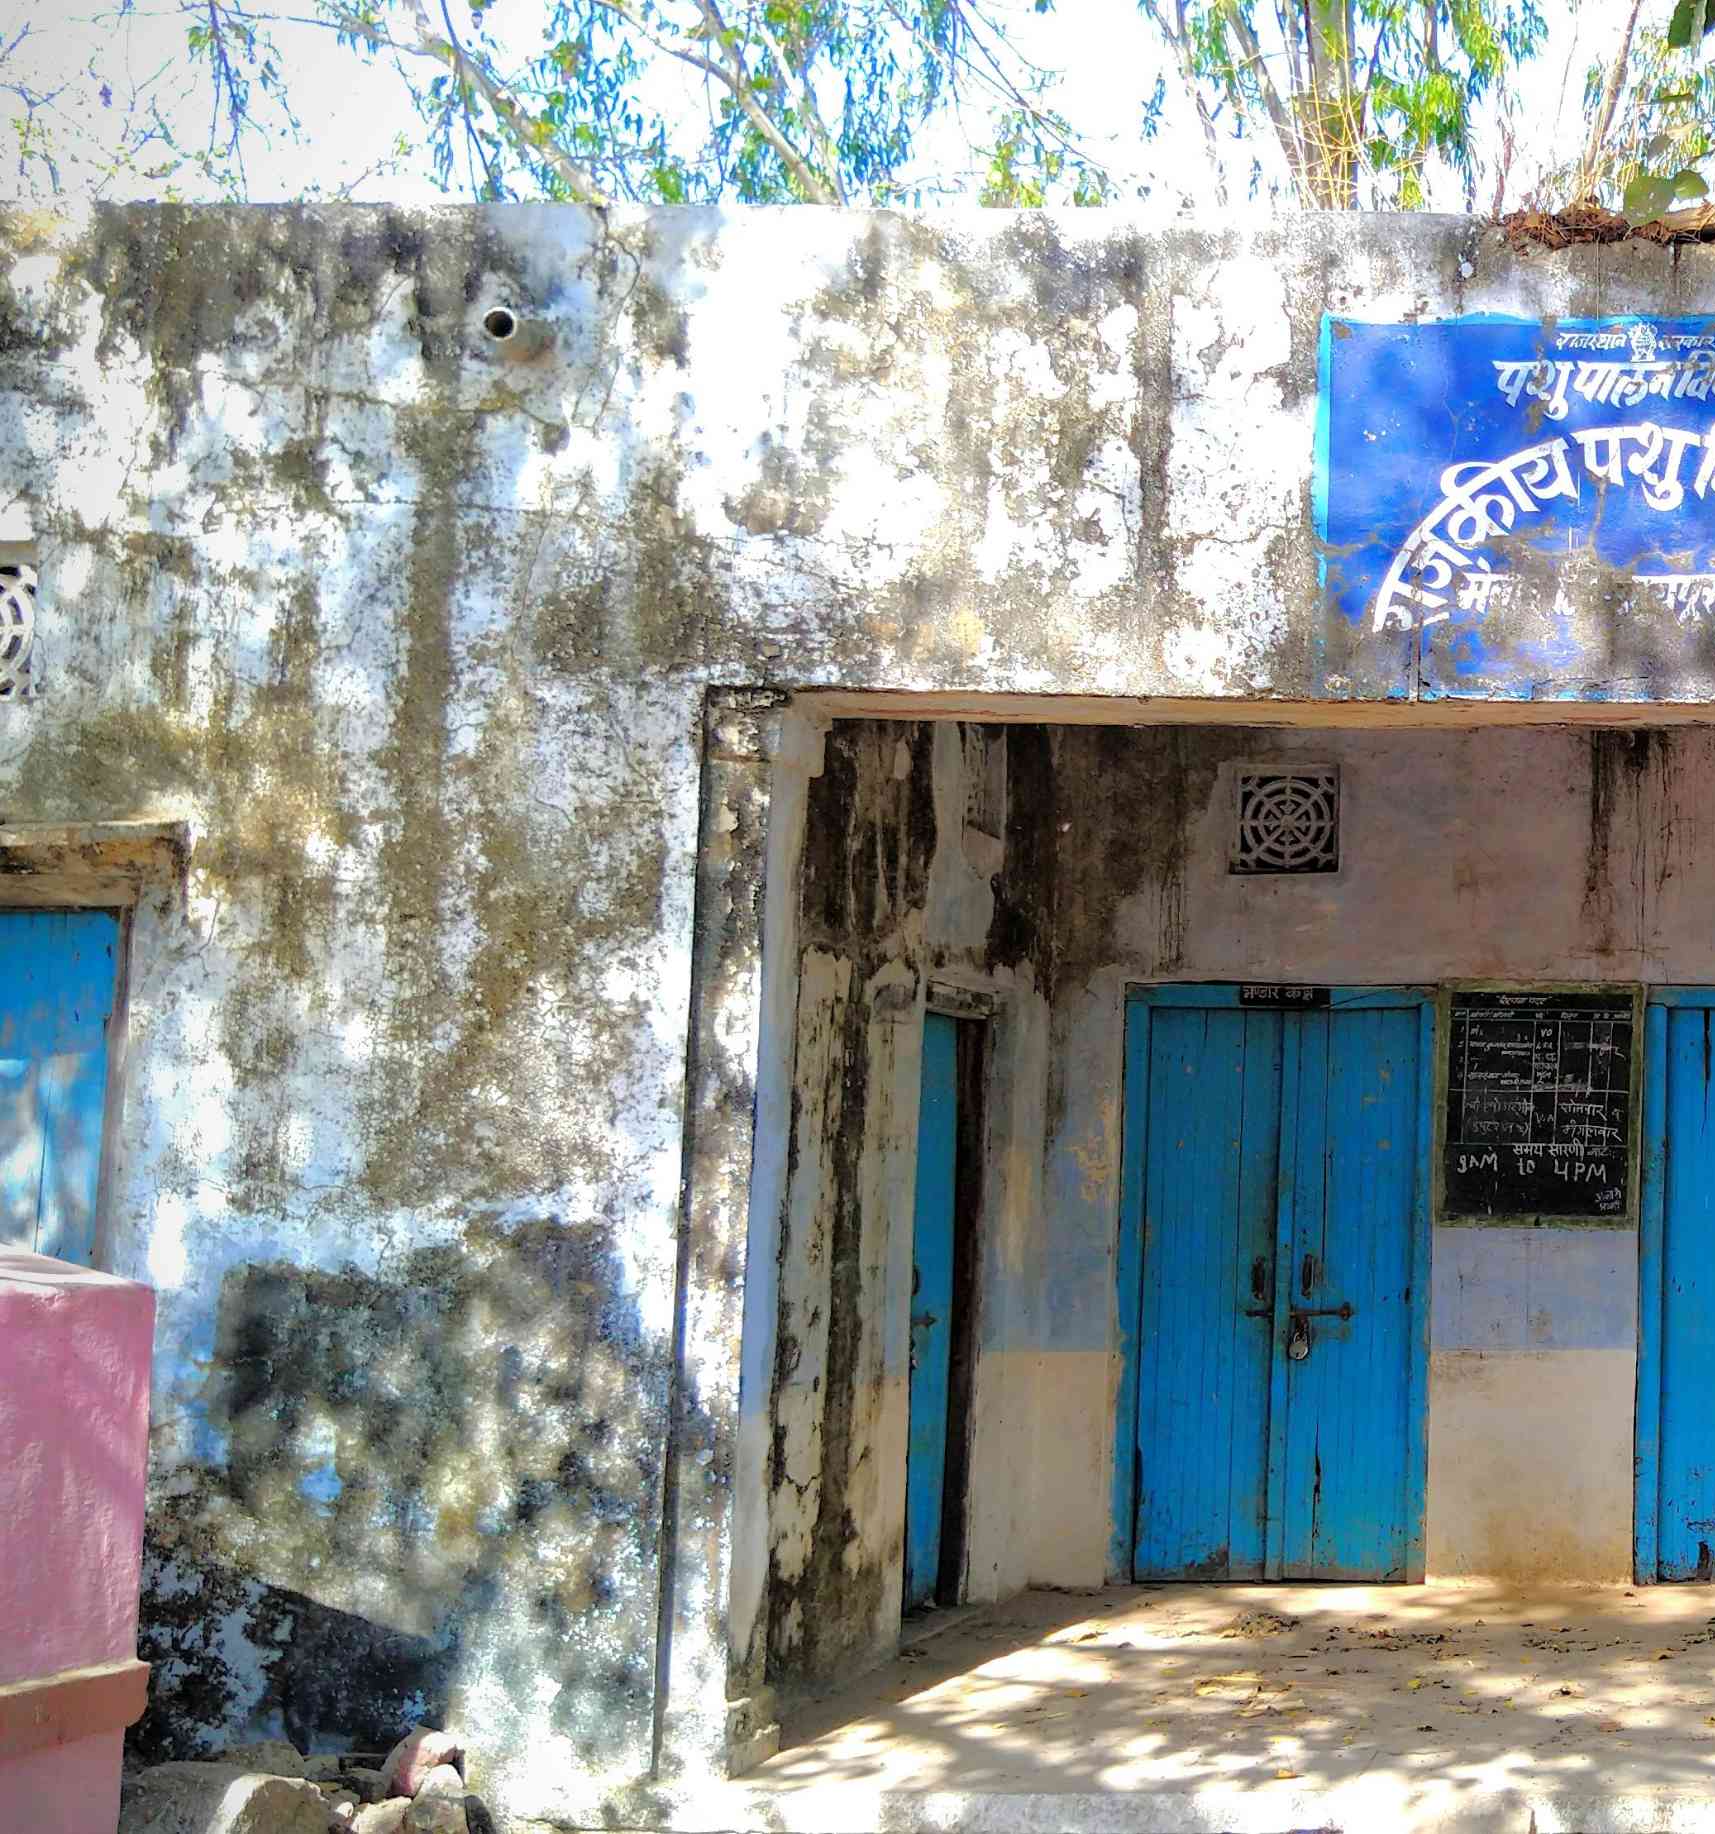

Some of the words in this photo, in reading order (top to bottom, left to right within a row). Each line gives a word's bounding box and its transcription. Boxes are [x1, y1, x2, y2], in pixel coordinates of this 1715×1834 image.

[1556, 333, 1627, 351] राजस्थान
[1372, 438, 1578, 632] राजकीय
[1572, 423, 1697, 511] पशु
